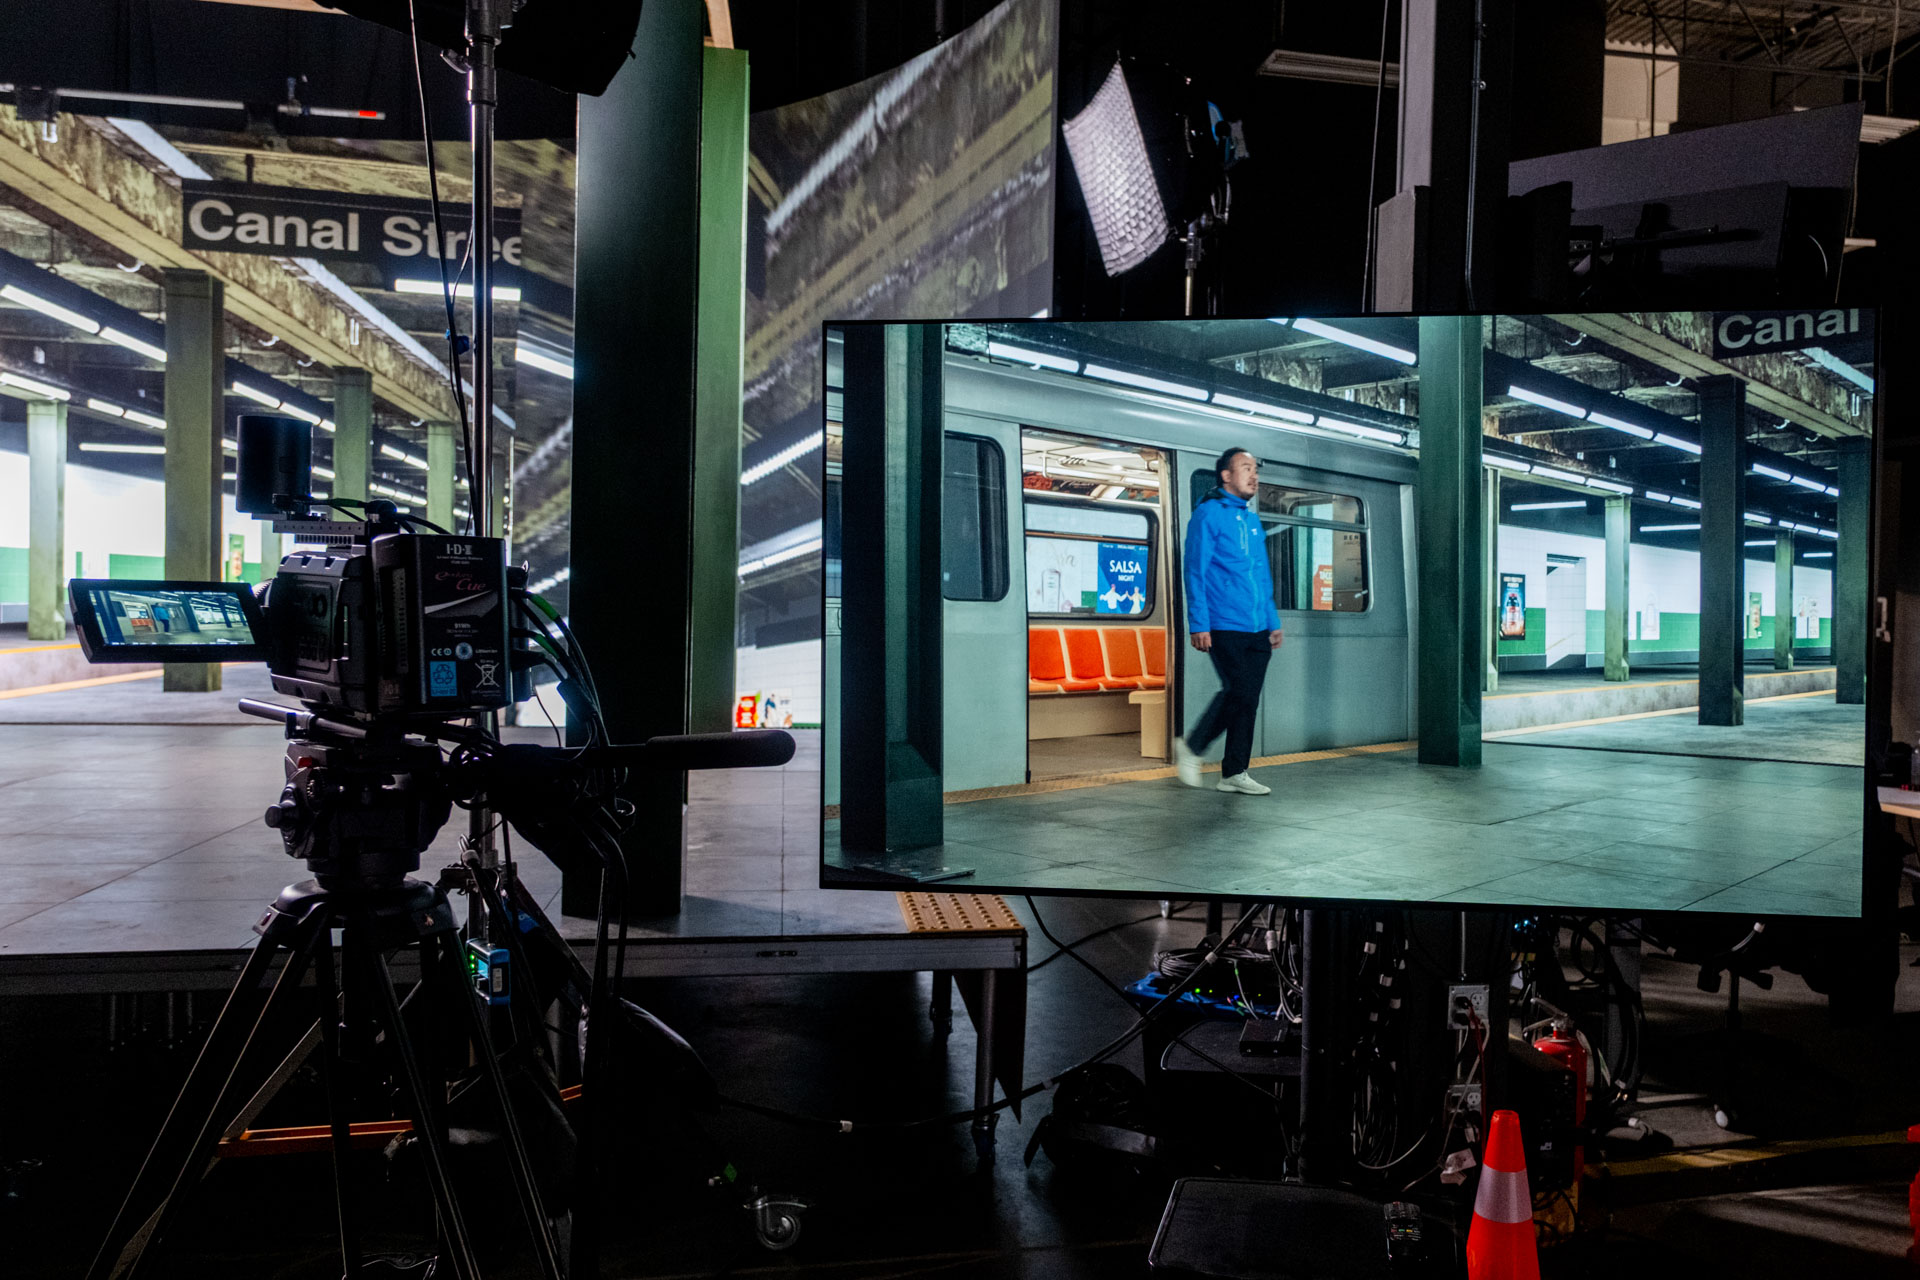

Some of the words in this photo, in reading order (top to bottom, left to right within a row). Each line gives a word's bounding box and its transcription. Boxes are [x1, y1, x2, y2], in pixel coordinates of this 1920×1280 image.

[188, 199, 359, 252] Canal
[1718, 308, 1859, 349] Canal
[1109, 559, 1142, 574] SALSA
[455, 577, 486, 591] Cue
